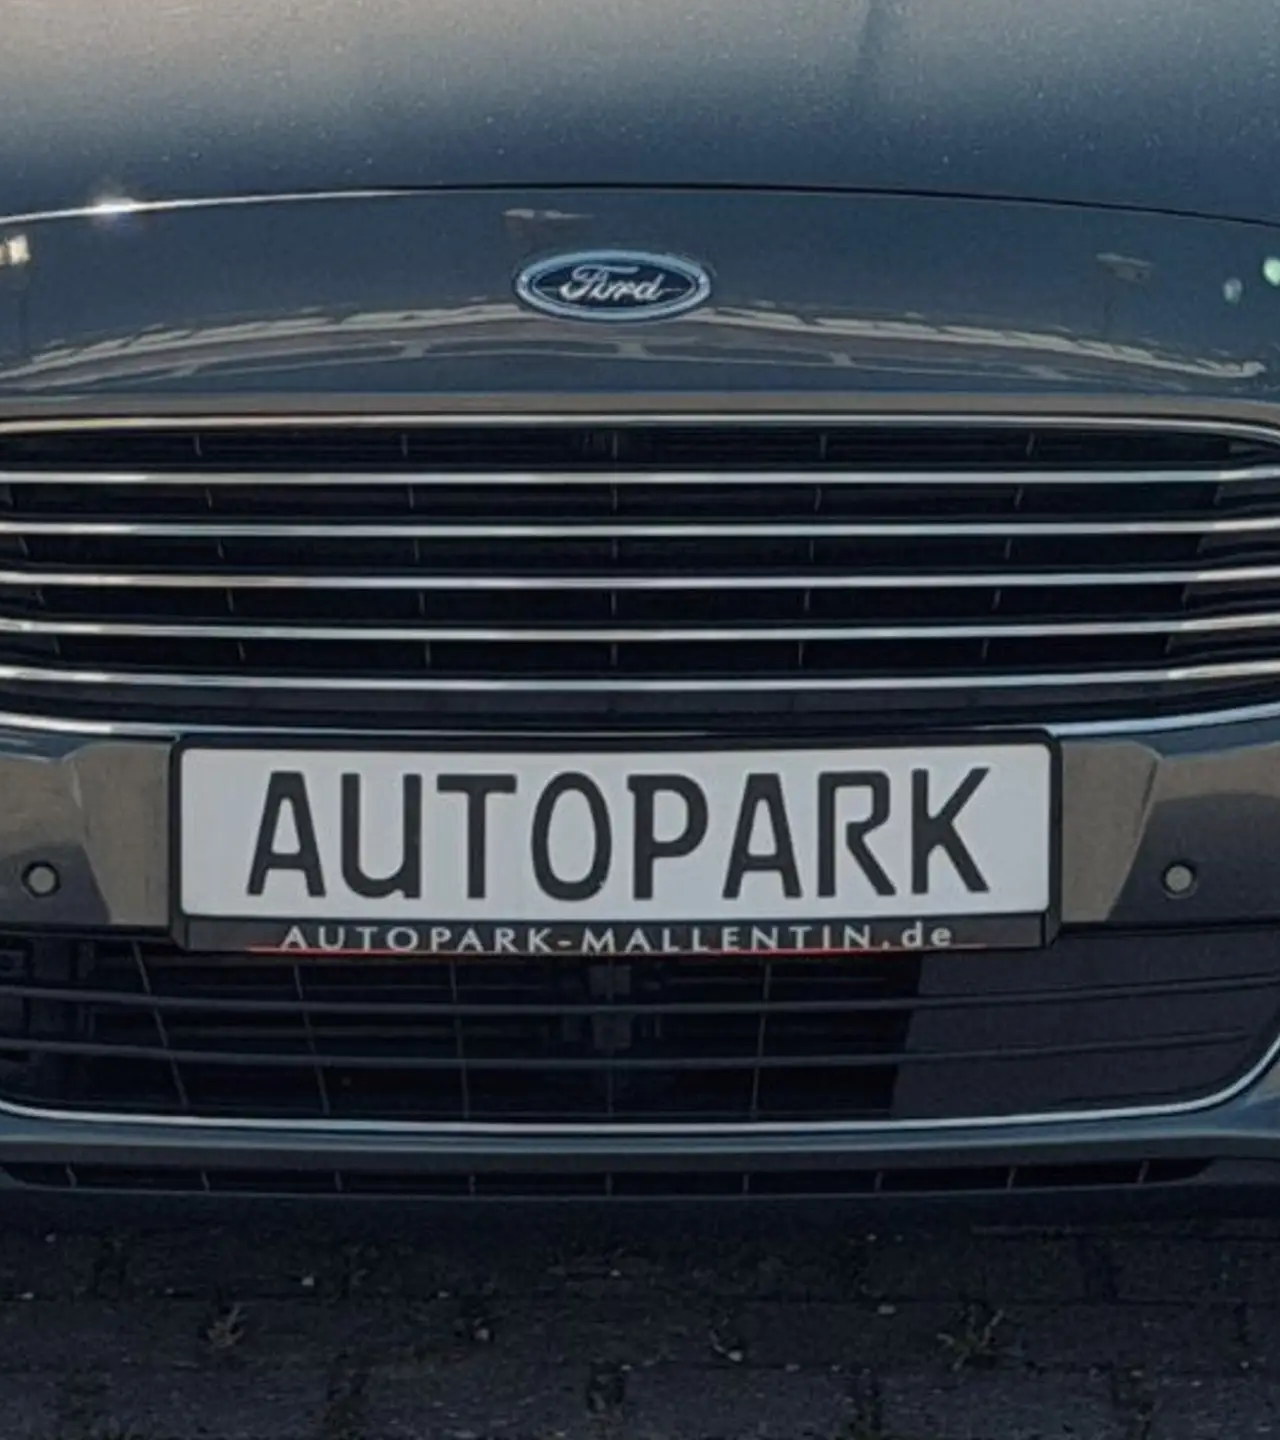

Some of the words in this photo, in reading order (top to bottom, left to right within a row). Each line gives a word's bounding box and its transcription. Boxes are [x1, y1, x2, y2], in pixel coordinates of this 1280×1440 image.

[558, 263, 667, 302] Ford
[246, 767, 990, 901] AUTOPARK
[280, 921, 952, 953] AUTOPARK-MALLENTIN.de
